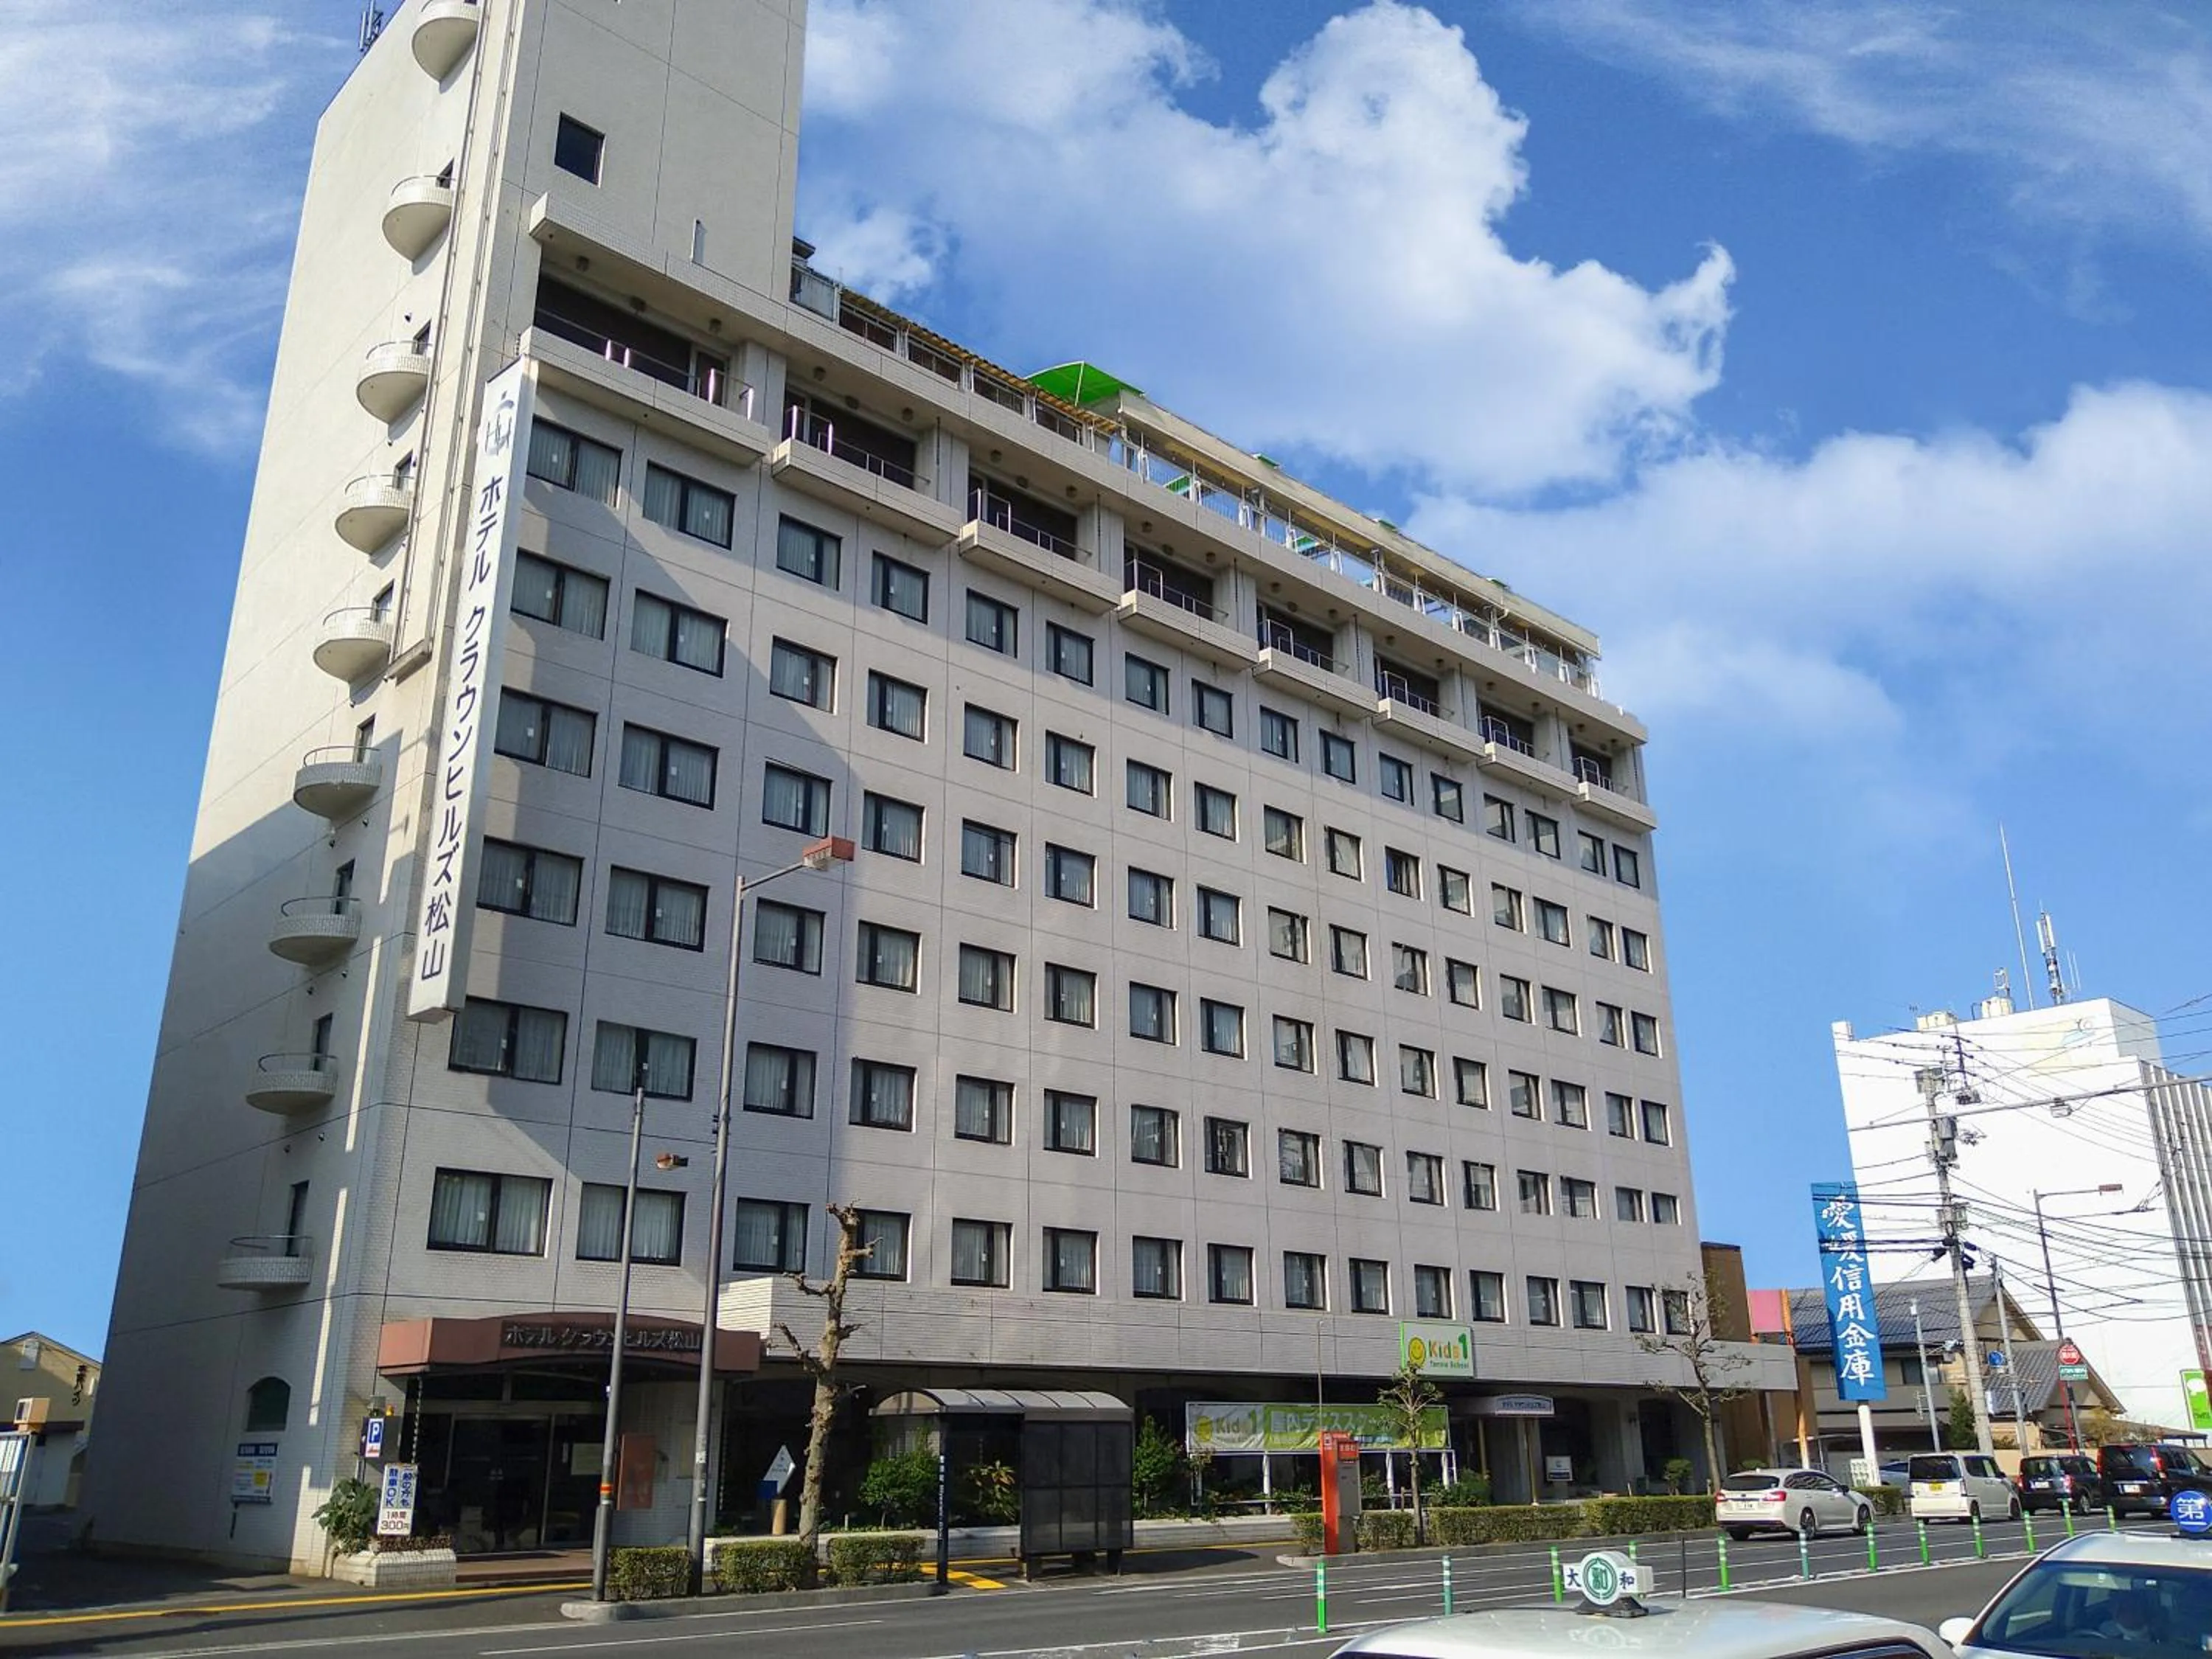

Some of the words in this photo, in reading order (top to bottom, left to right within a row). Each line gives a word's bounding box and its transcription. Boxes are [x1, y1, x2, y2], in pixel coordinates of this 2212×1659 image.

[469, 476, 504, 591] ホテル
[421, 605, 485, 981] クラウンヒルズ松山
[371, 1424, 380, 1441] P
[2175, 1498, 2208, 1526] 第一
[1567, 1568, 1582, 1587] 大
[1619, 1571, 1635, 1590] 和
